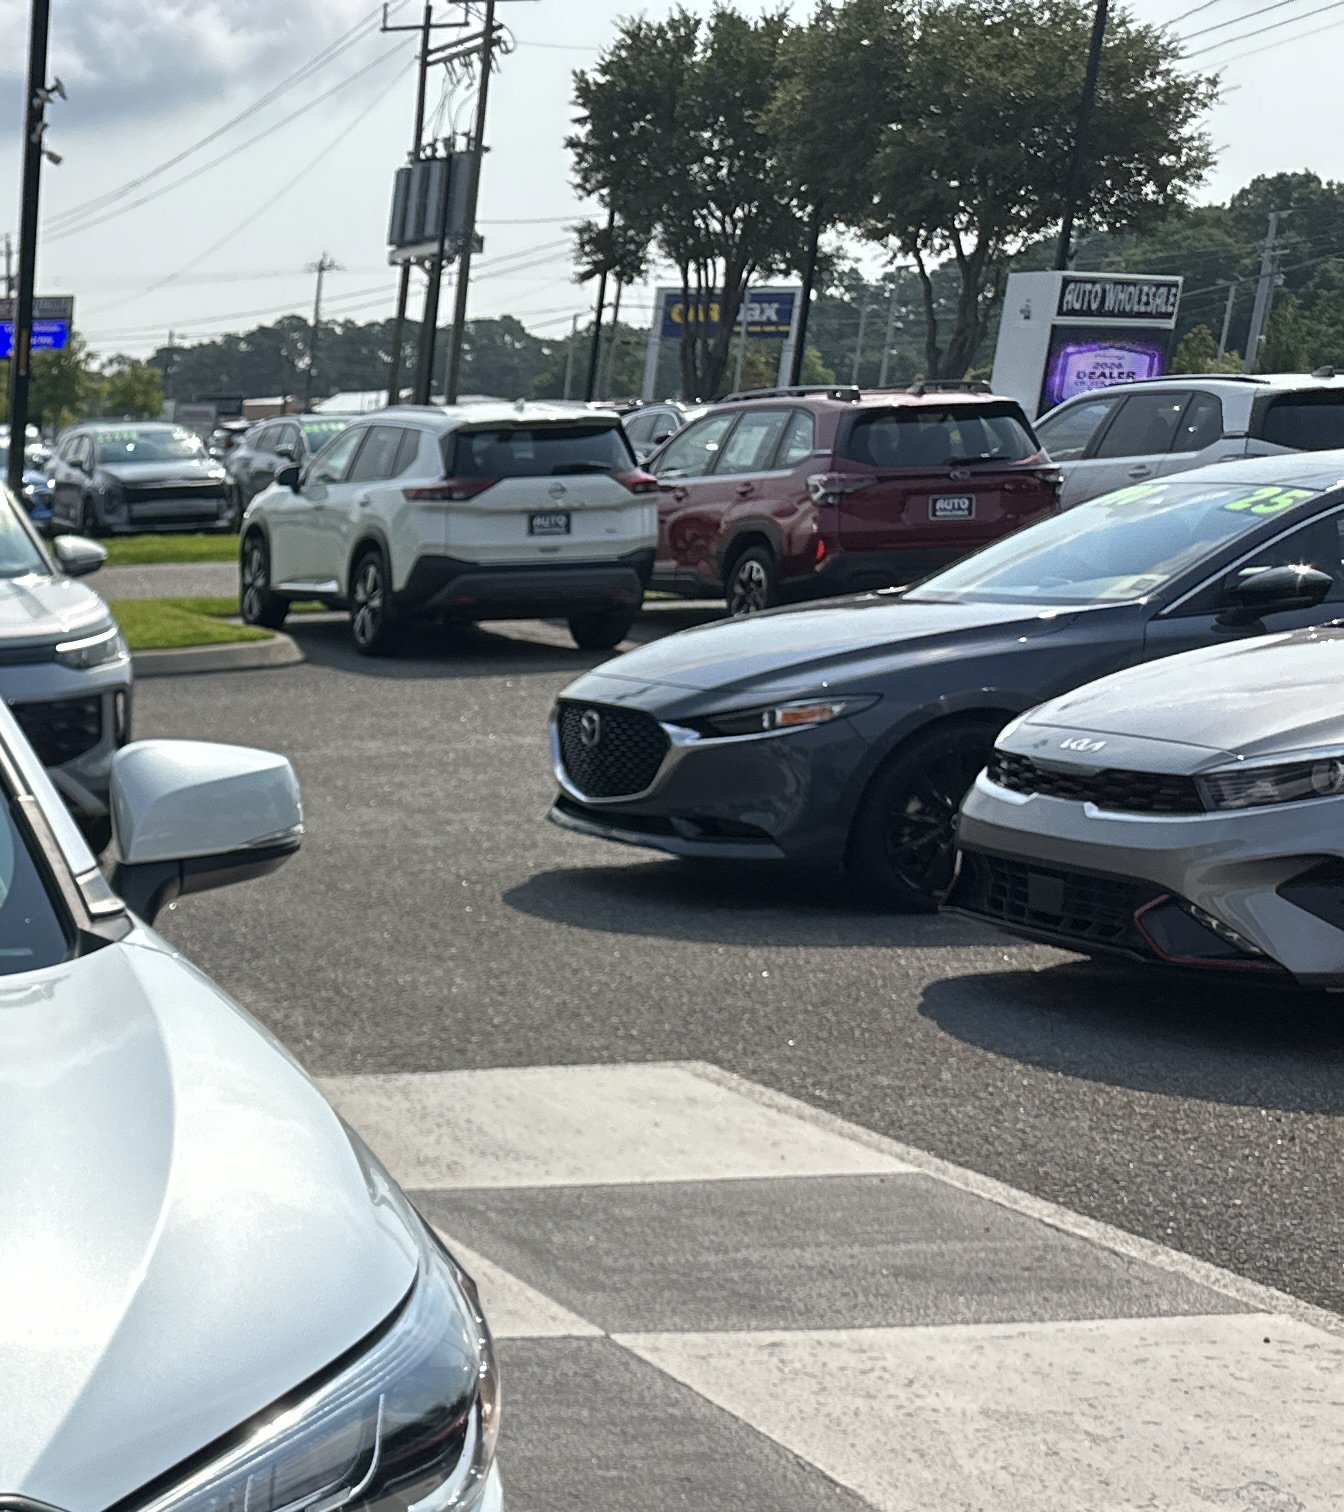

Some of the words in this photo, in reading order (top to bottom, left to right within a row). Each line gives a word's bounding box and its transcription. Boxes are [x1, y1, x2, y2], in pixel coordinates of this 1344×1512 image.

[1063, 282, 1102, 312] AUTO
[1104, 284, 1178, 313] WHOLESALE
[1075, 371, 1136, 380] DEALER
[936, 498, 970, 510] AUTO
[1223, 486, 1315, 514] 25
